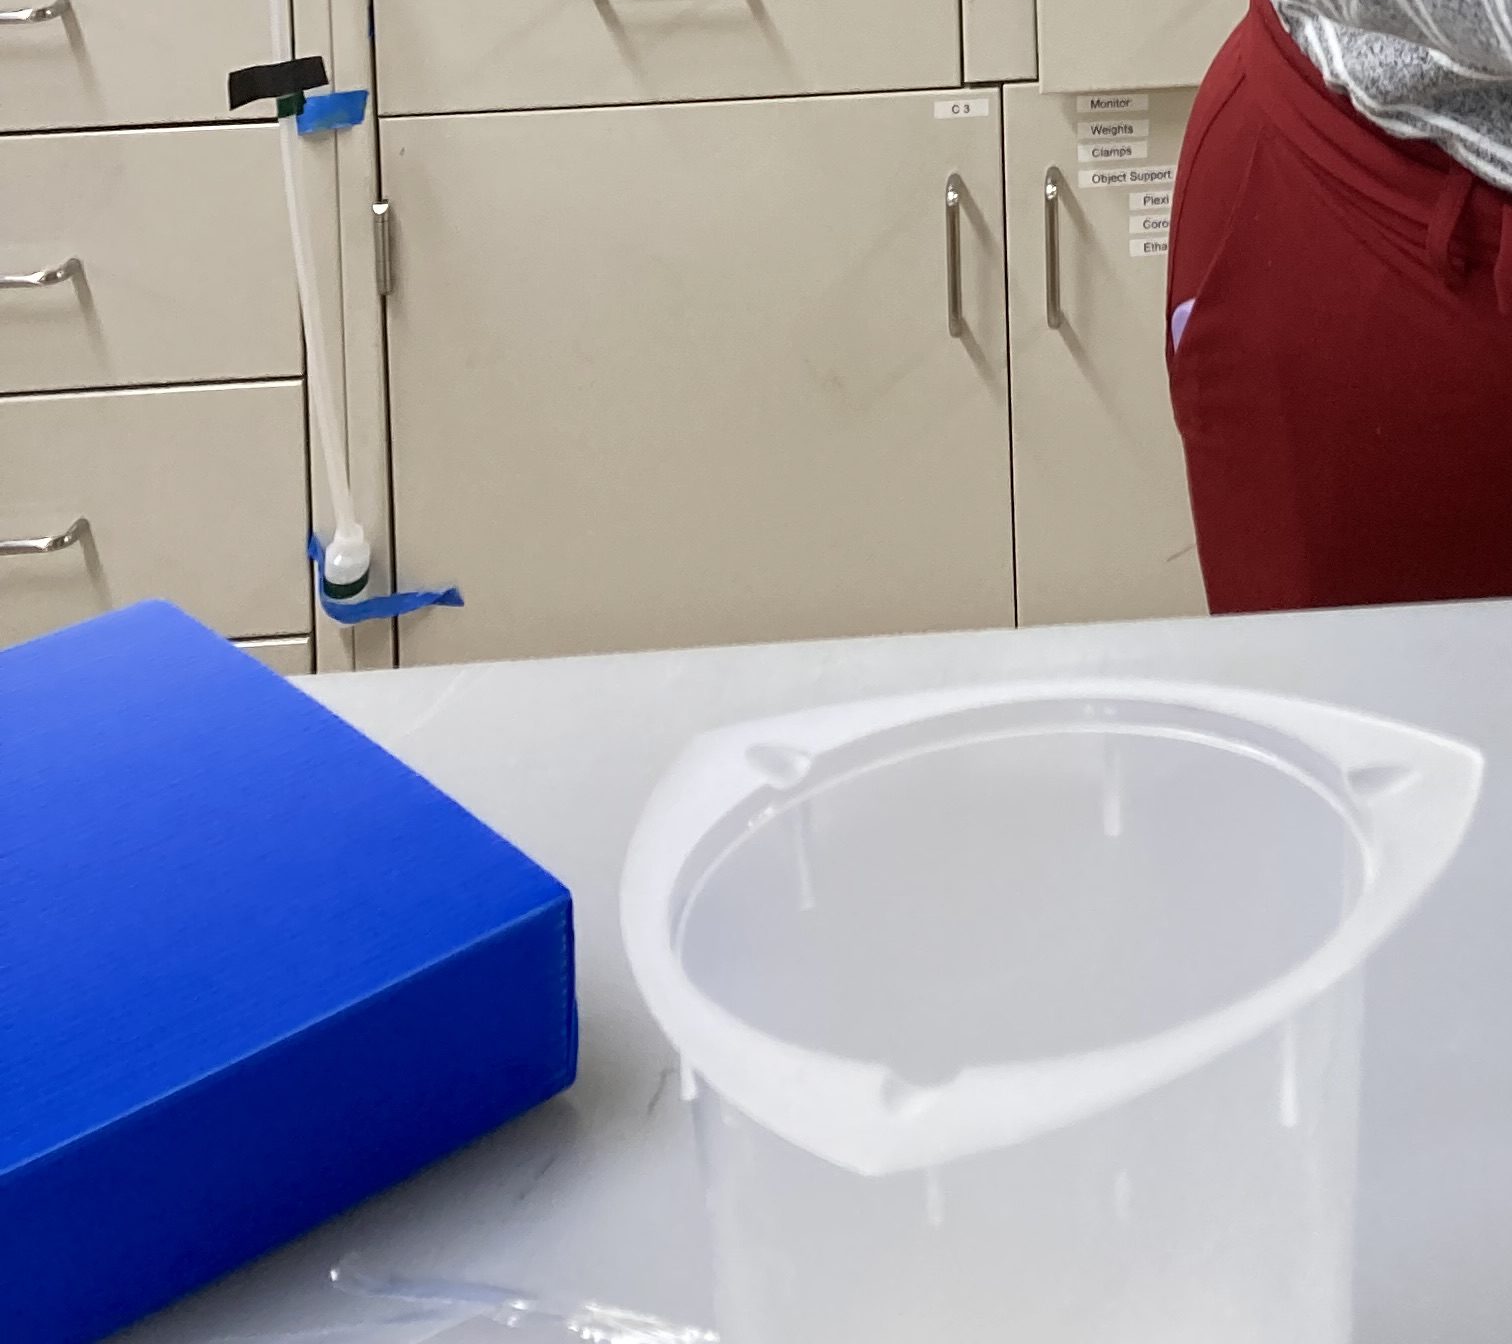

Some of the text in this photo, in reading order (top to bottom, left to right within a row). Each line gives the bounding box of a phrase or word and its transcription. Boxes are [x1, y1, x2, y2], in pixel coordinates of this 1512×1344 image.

[951, 103, 970, 114] C 3
[1090, 98, 1131, 109] Monitor
[1090, 124, 1134, 136] Weights
[1091, 147, 1132, 158] Clamps
[1091, 170, 1171, 184] Object Support
